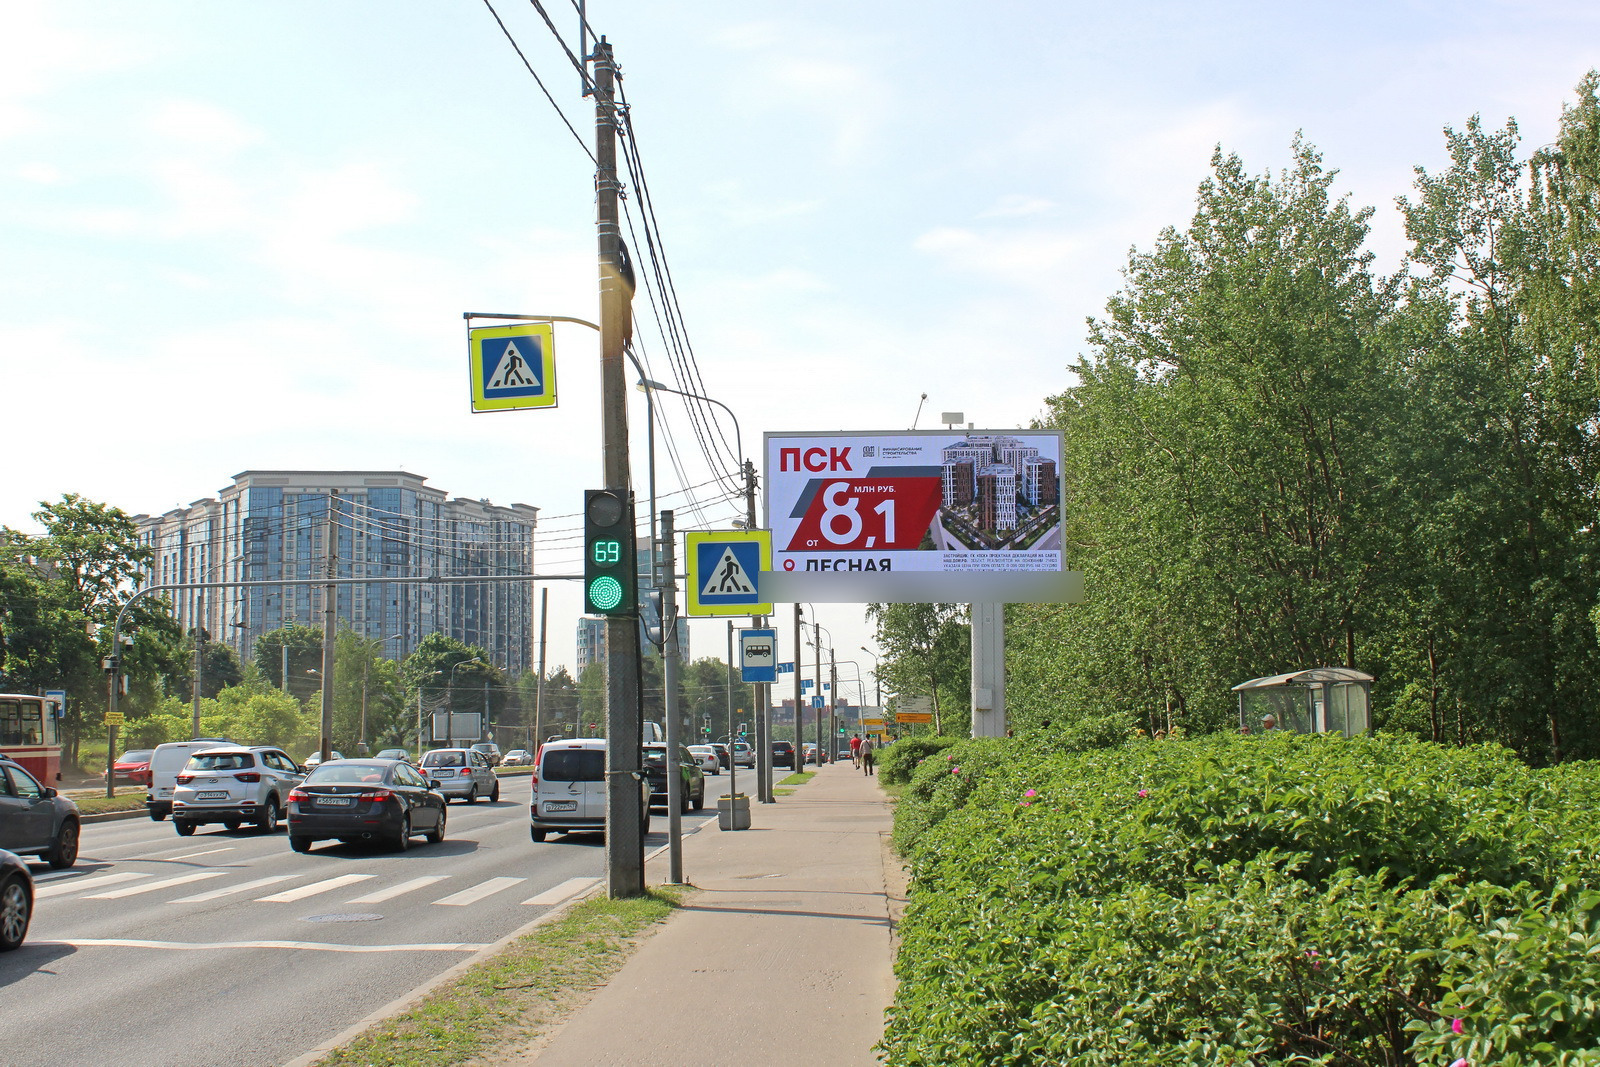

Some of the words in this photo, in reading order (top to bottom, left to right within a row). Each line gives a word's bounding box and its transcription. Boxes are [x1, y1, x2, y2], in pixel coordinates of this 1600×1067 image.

[780, 447, 853, 472] ПСК
[877, 485, 897, 493] РУБ.
[595, 541, 620, 562] 69
